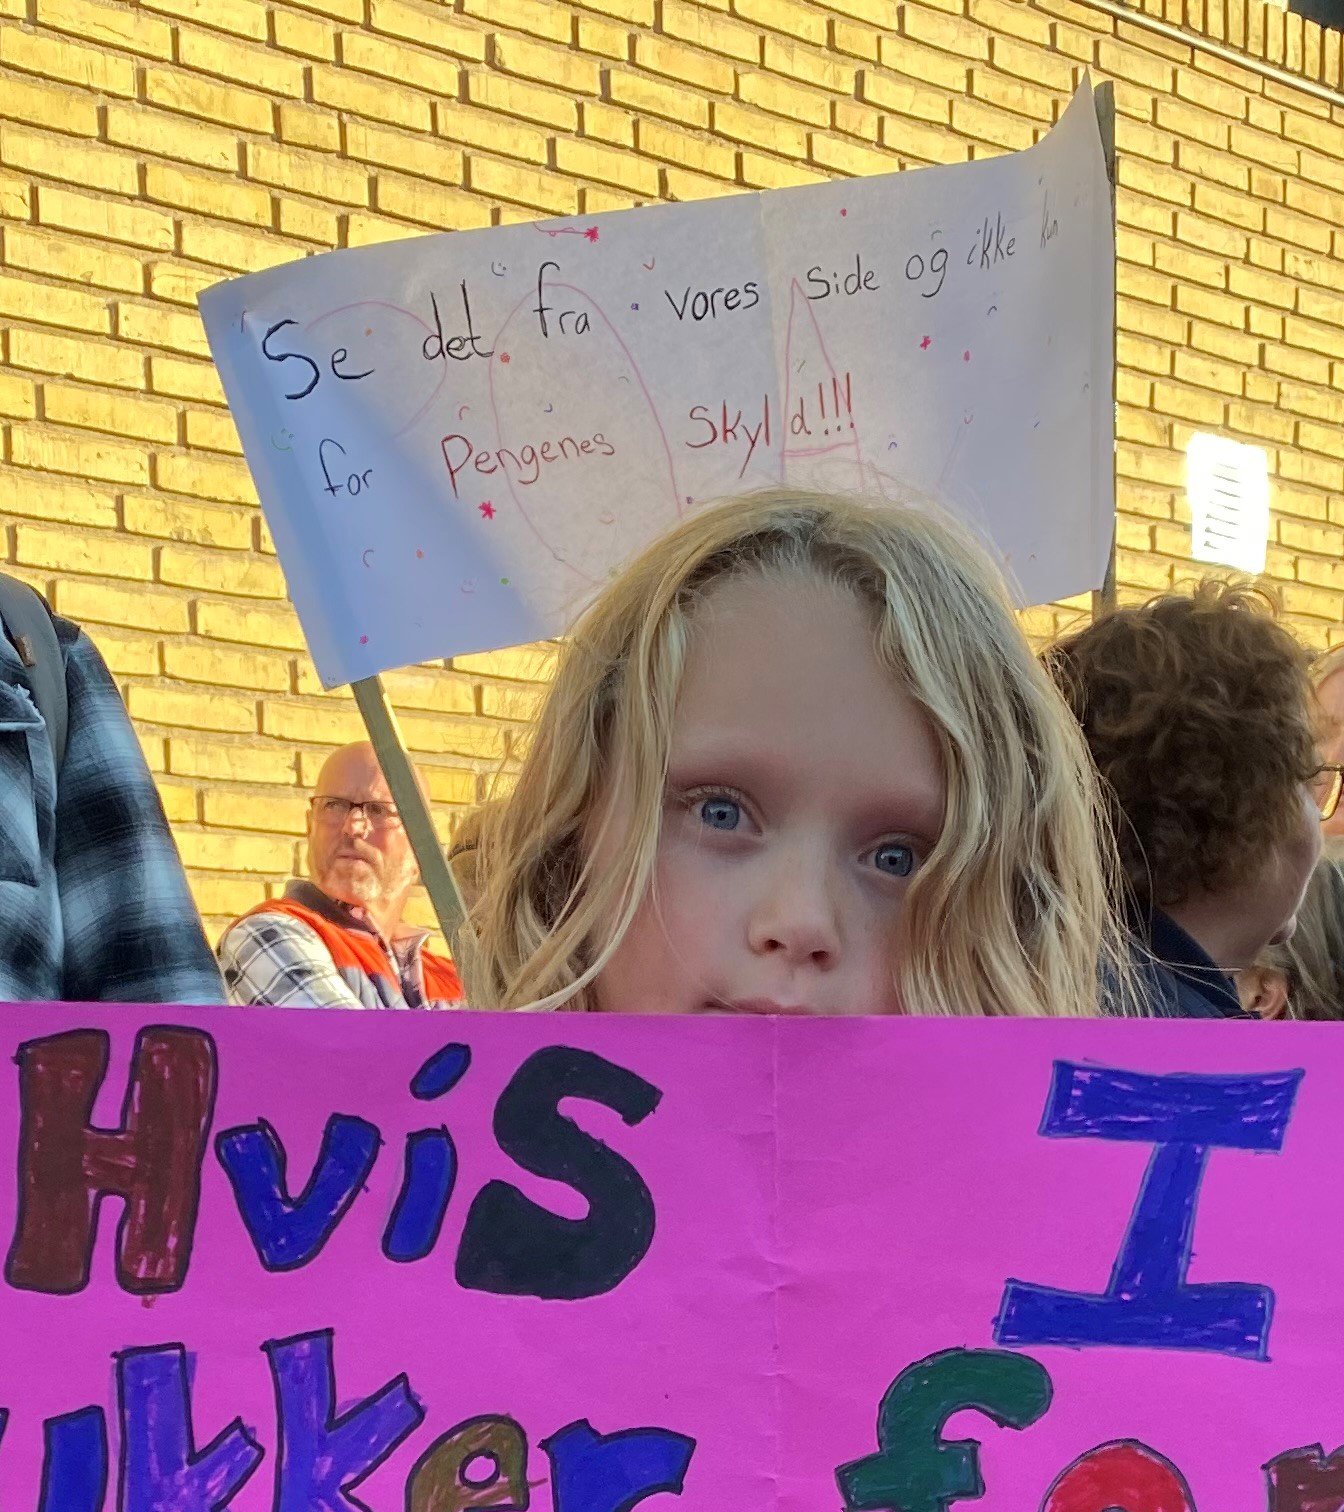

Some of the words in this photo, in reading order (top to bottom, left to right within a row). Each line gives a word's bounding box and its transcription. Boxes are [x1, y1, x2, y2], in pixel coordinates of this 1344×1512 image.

[261, 318, 375, 400] Se
[421, 279, 494, 361] det
[532, 261, 591, 339] fra
[905, 248, 948, 298] og
[967, 211, 1016, 270] ikke
[318, 438, 373, 498] for
[992, 1058, 1306, 1362] I
